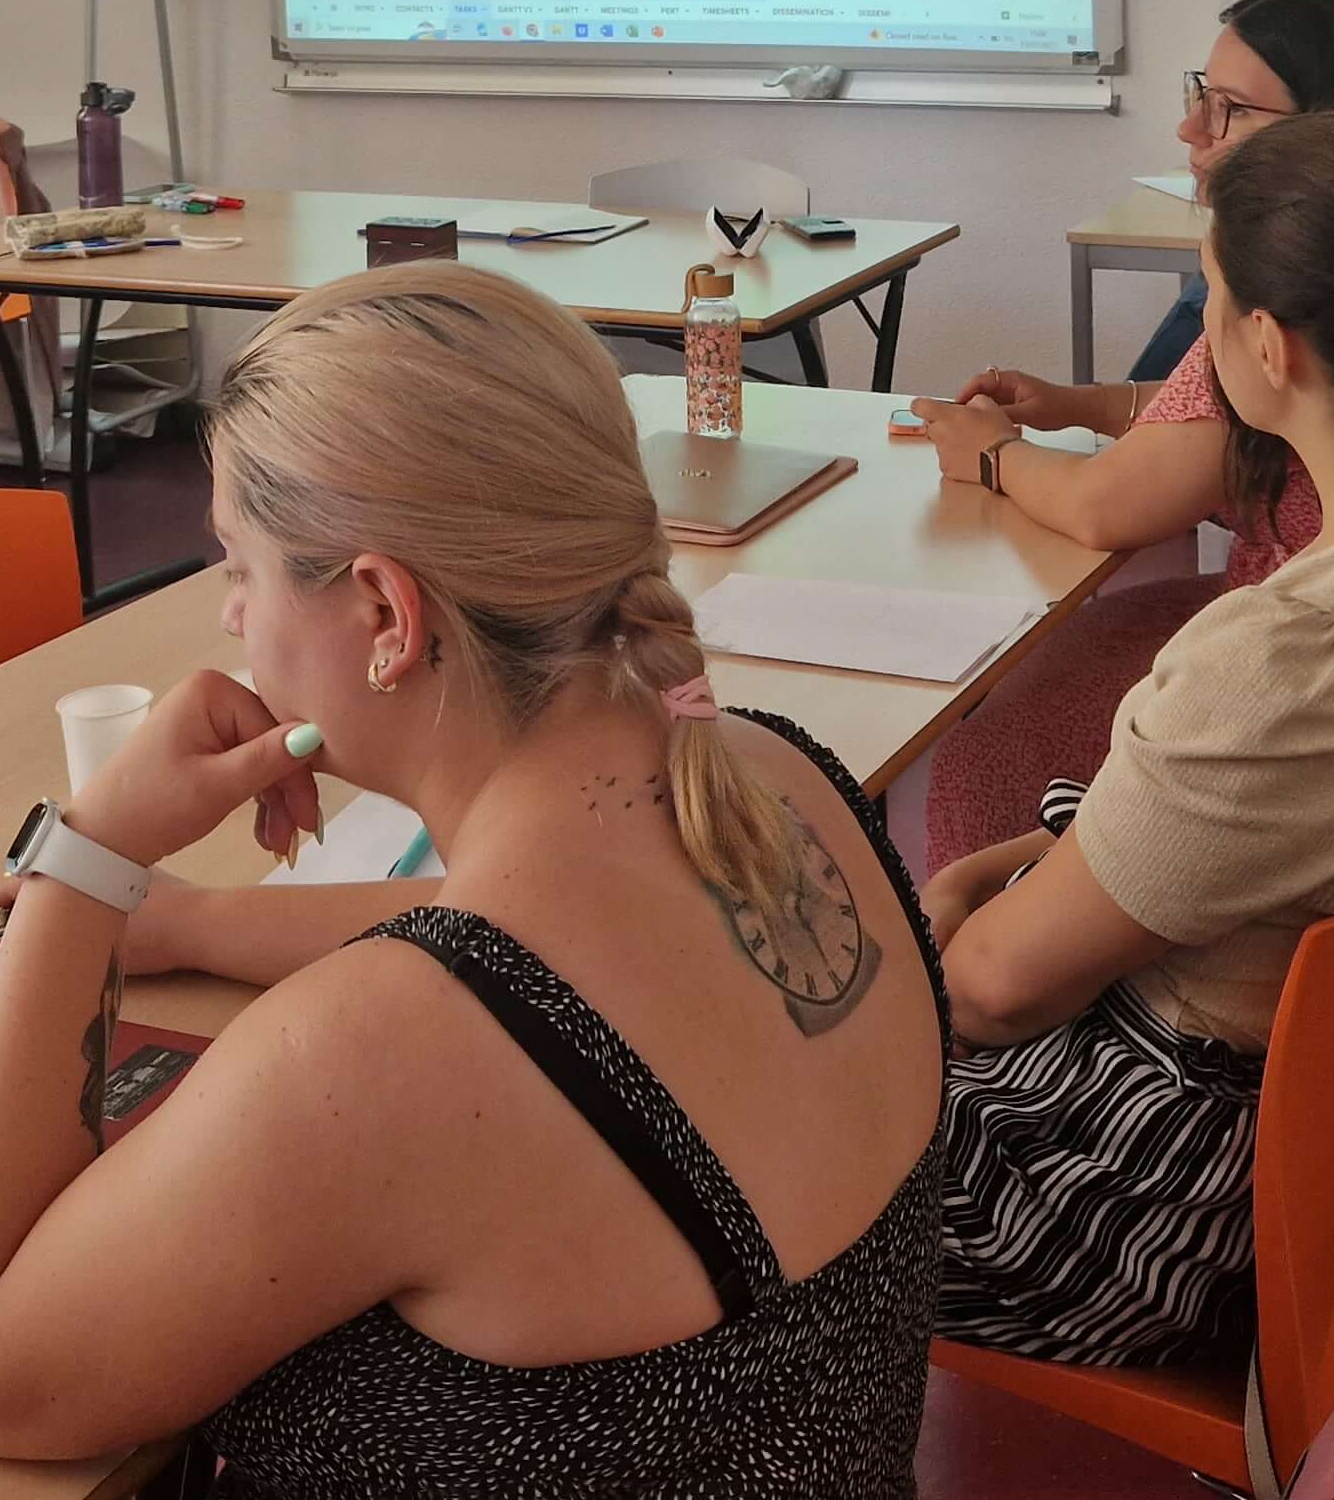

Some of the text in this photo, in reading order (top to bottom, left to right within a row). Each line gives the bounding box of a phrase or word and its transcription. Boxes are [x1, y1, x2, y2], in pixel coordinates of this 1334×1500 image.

[395, 4, 433, 12] CONTACTS
[600, 6, 638, 14] MEETINGS
[702, 7, 749, 15] TIMESHEETS
[772, 7, 833, 16] DISSEMINATION
